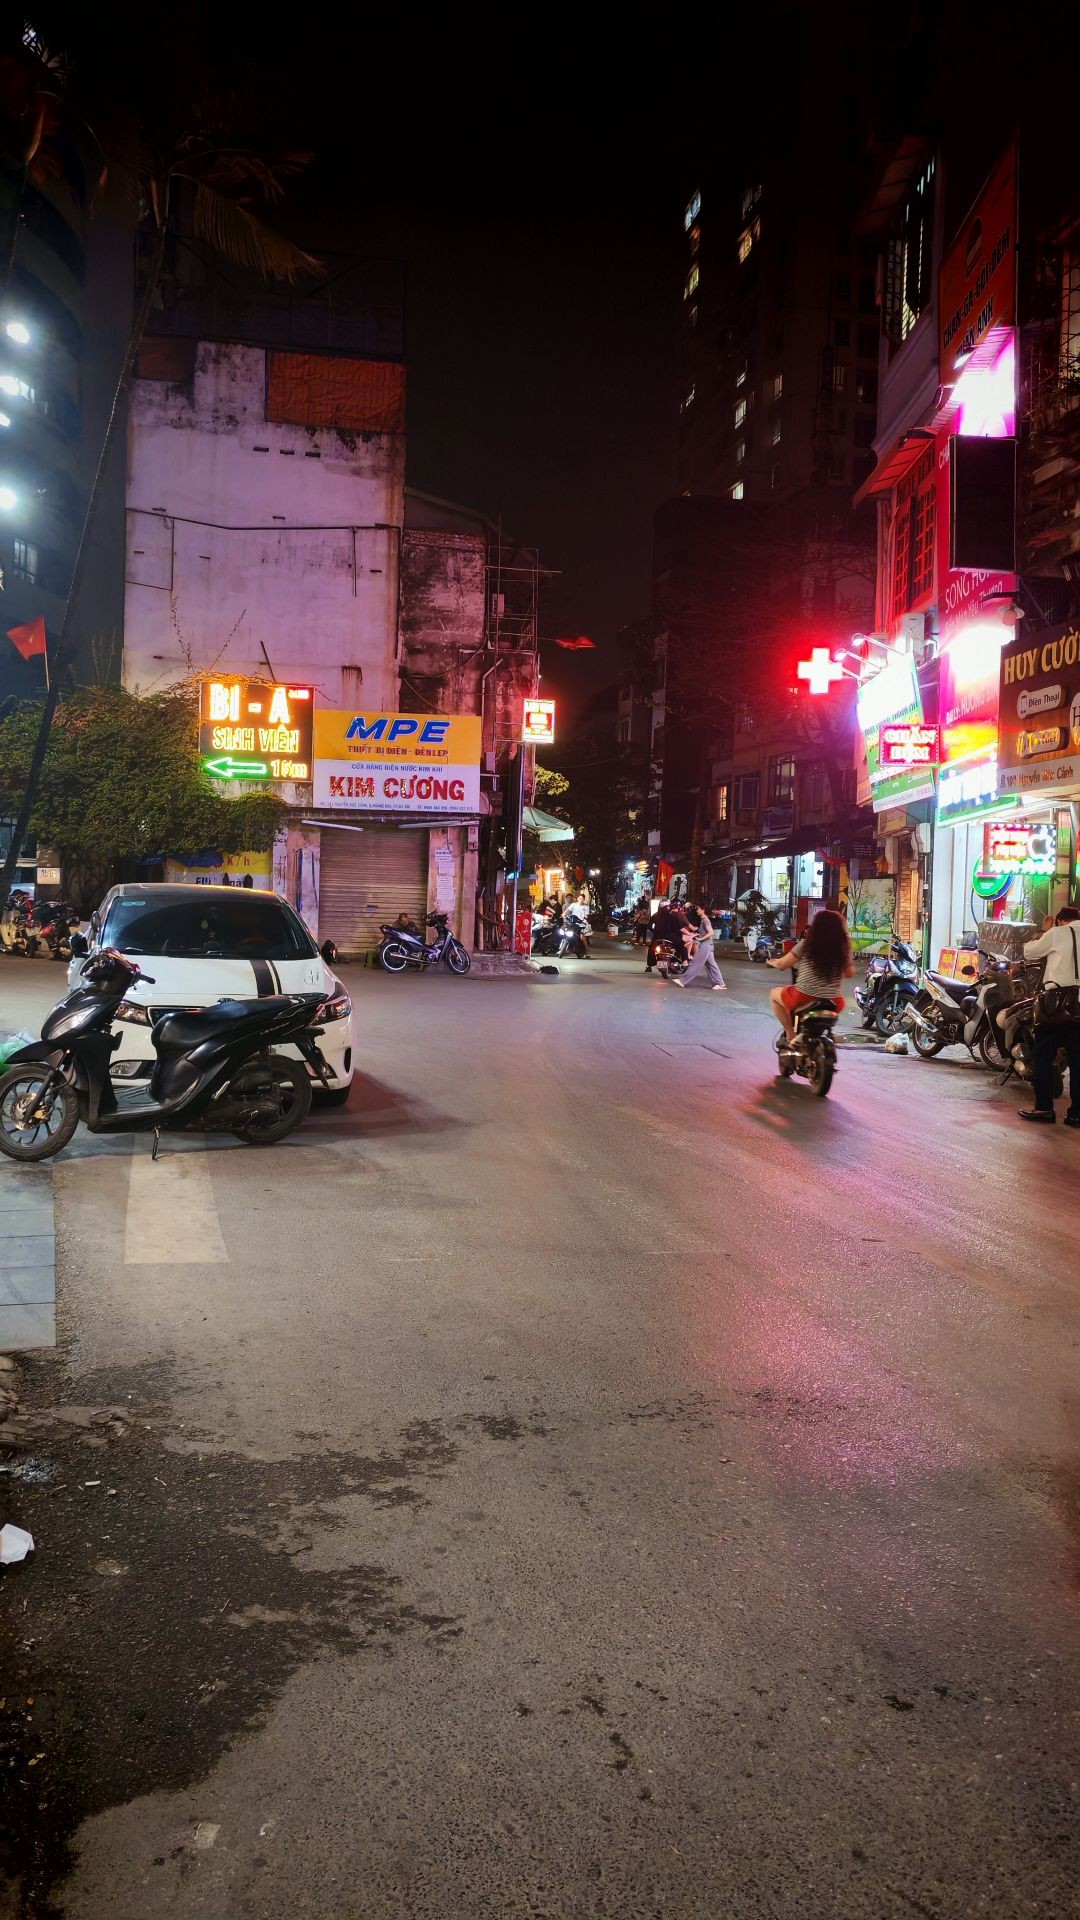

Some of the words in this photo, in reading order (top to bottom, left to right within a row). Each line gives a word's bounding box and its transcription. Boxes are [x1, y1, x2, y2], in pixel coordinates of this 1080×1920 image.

[945, 572, 970, 615] SONG
[1004, 648, 1038, 685] HUY
[1041, 626, 1080, 673] CƯỜ
[210, 684, 240, 721] BI
[268, 687, 291, 724] A
[212, 726, 255, 751] SINH
[258, 724, 299, 753] VIÊN
[346, 716, 451, 743] MPE
[329, 776, 375, 798] KIM
[384, 774, 465, 801] CƯƠNG
